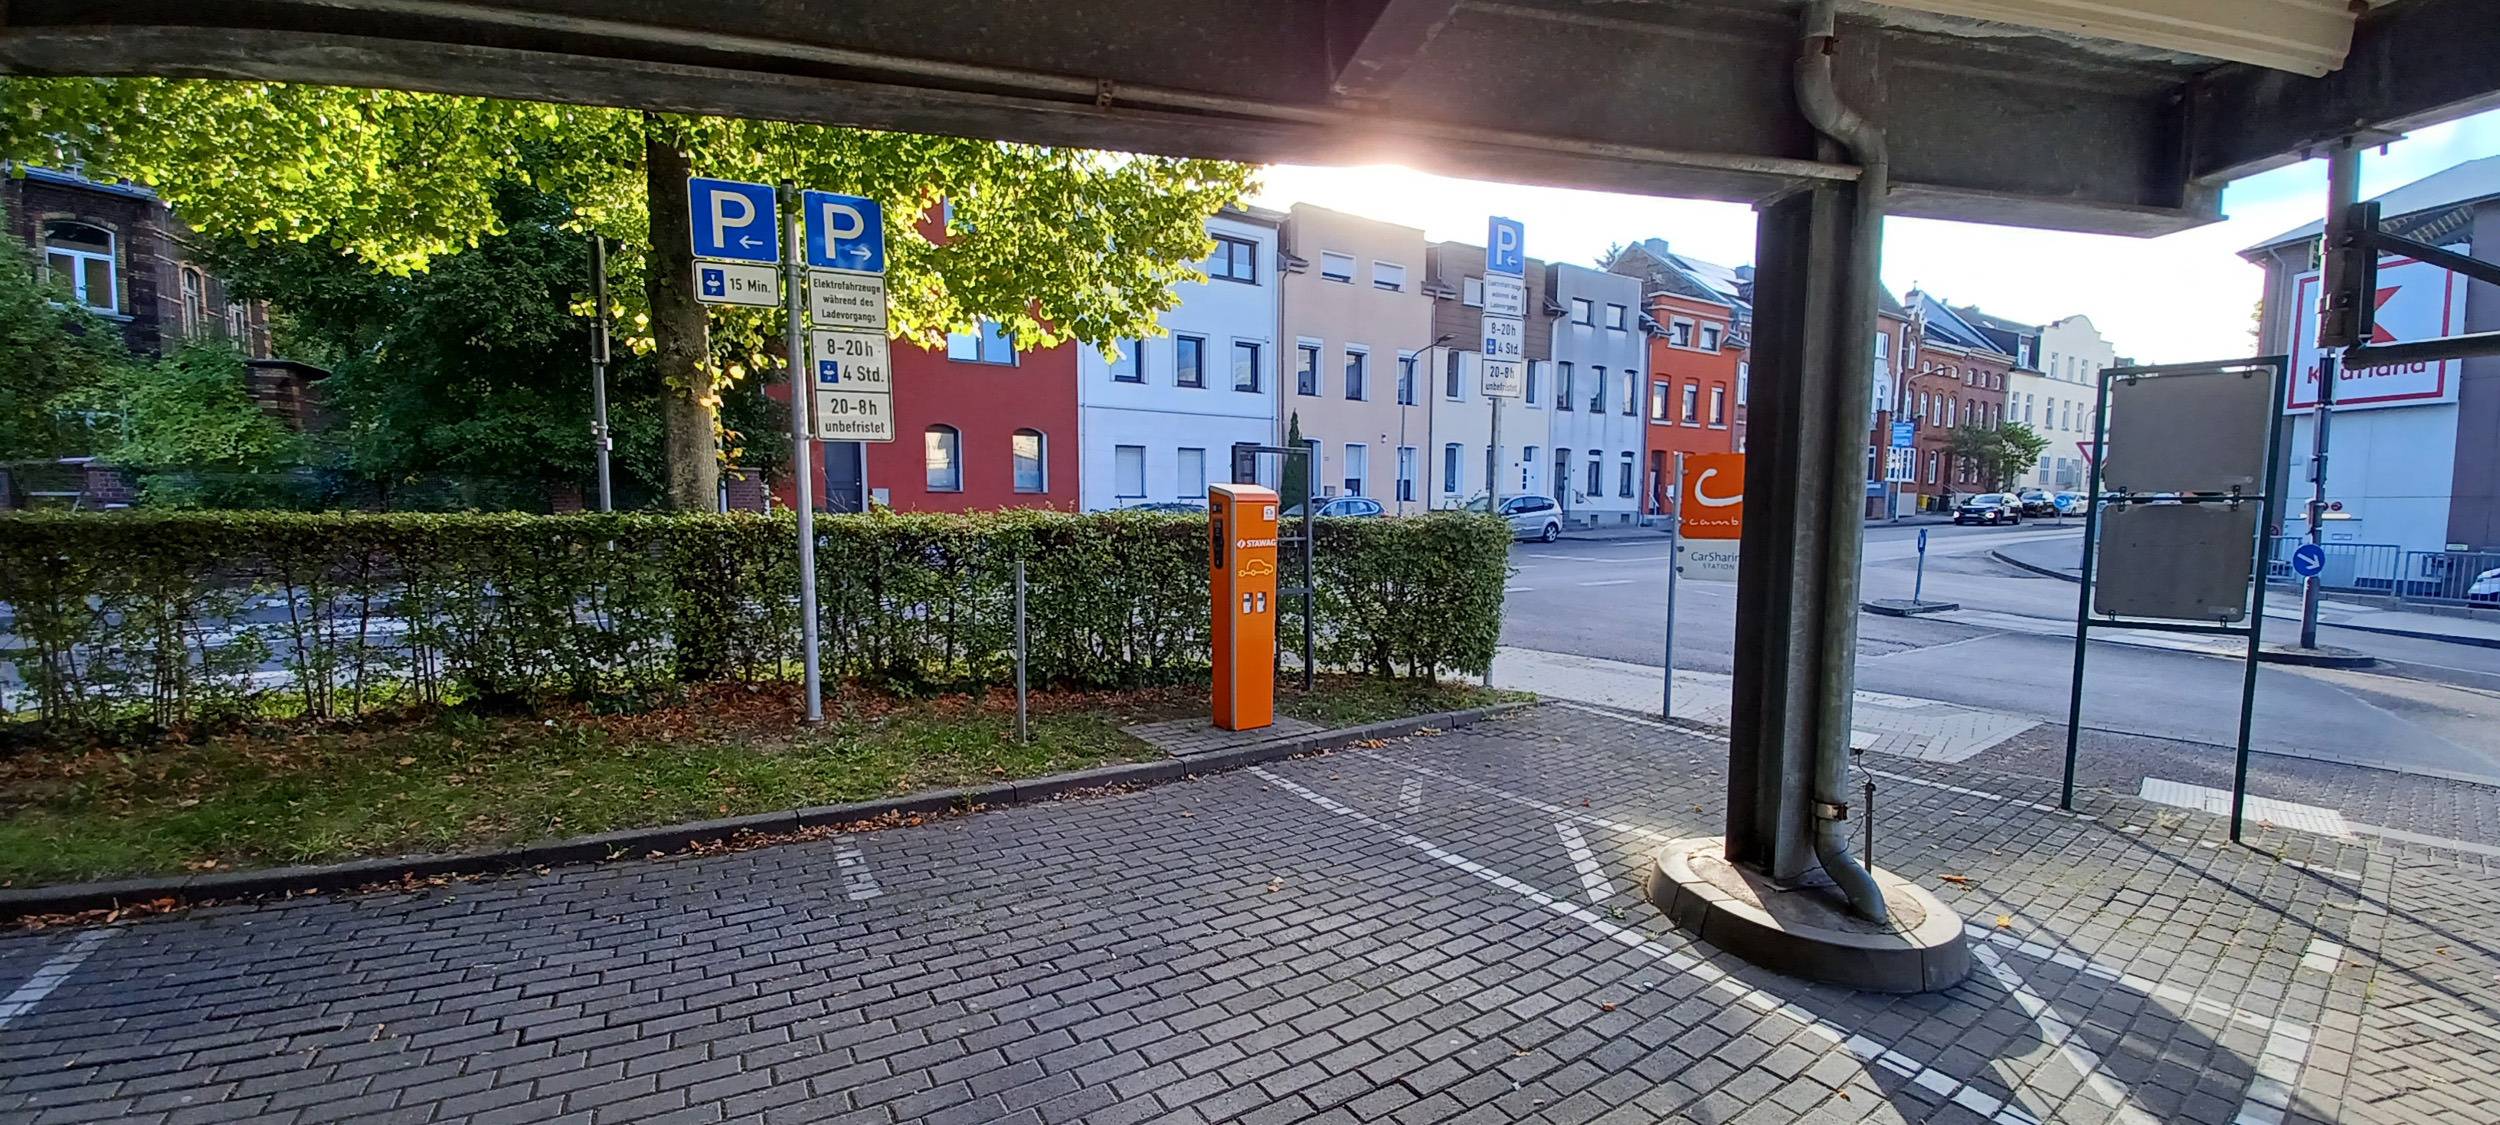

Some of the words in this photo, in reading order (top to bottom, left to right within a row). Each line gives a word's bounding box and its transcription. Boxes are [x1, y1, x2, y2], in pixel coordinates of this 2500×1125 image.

[710, 189, 756, 248] P
[822, 202, 865, 260] P
[1496, 223, 1518, 265] P
[729, 277, 743, 291] 15
[747, 279, 772, 294] Min.
[813, 278, 881, 295] Elektrofahrzeuge
[822, 294, 857, 306] während
[859, 297, 875, 307] des
[821, 308, 877, 324] Ladevorgangs
[1498, 341, 1503, 353] 4
[1505, 342, 1520, 355] Std.
[842, 364, 852, 381] 4
[856, 365, 885, 383] Std.
[1485, 381, 1518, 392] unbefr
[825, 420, 886, 434] unbefristet
[1246, 538, 1277, 548] STAWAG
[1702, 562, 1735, 570] STATION
